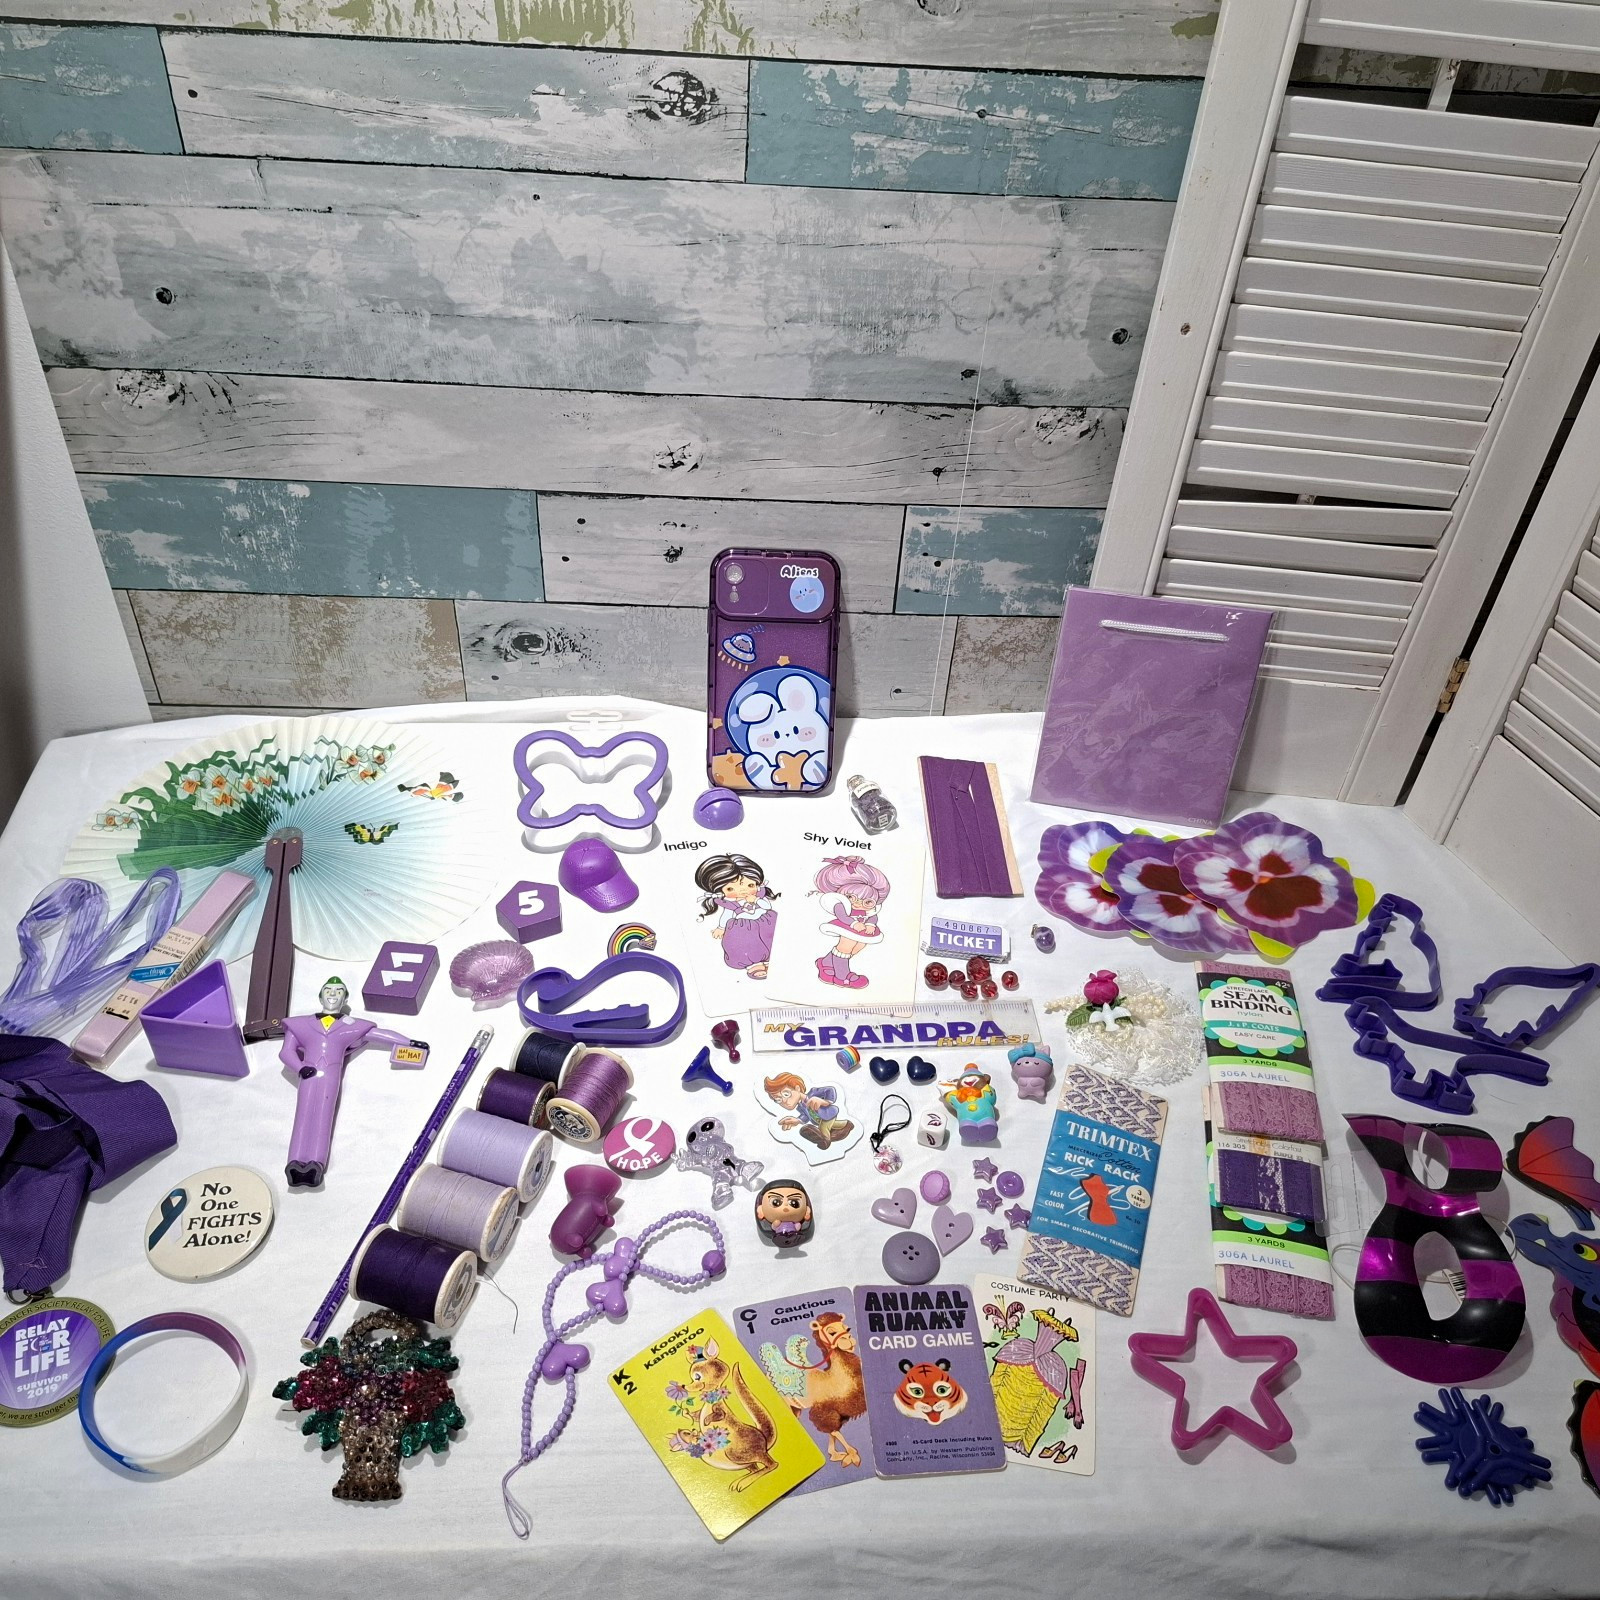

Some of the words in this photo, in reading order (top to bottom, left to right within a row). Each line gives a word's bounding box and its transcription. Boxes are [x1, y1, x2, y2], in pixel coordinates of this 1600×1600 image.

[781, 565, 818, 578] Aliens
[1187, 817, 1213, 825] CHINA
[664, 839, 708, 852] Indigo
[803, 832, 829, 845] Shy
[834, 836, 872, 851] Violet
[518, 889, 544, 915] 5
[944, 921, 990, 934] 490867
[936, 932, 996, 950] TICKET
[1223, 990, 1277, 1004] SEAM
[1211, 1000, 1292, 1016] BINDING
[764, 1023, 805, 1033] MY
[784, 1021, 1008, 1047] GRANDPA
[1251, 1024, 1280, 1032] COATS
[936, 1034, 1029, 1047] RULES!
[407, 1052, 421, 1060] HA!
[1249, 1059, 1278, 1067] YARDS
[1250, 1072, 1290, 1082] LAUREL
[1067, 1121, 1153, 1162] TRIMTEX
[1272, 1142, 1302, 1152] Colorfast
[1068, 1144, 1103, 1159] MERCERIZED
[616, 1152, 663, 1171] HOPE
[1064, 1152, 1095, 1168] RICK
[1104, 1163, 1141, 1183] RACK
[200, 1183, 232, 1197] No
[1050, 1190, 1064, 1199] FAST
[201, 1199, 239, 1212] One
[1044, 1199, 1065, 1210] COLOR
[187, 1212, 262, 1230] FIGHTS
[182, 1230, 251, 1248] Alone!
[1050, 1219, 1070, 1229] SMART
[1072, 1226, 1107, 1242] DECORATIVE
[1109, 1238, 1139, 1254] TRIMMING
[1256, 1238, 1286, 1248] YARDS
[1218, 1250, 1248, 1261] 306A
[1252, 1254, 1295, 1269] LAUREL
[990, 1281, 1036, 1296] COSTUME
[1039, 1291, 1071, 1303] PARTY
[774, 1298, 836, 1316] Cautious
[864, 1290, 969, 1312] ANIMAL
[0, 1308, 33, 1330] CANCER
[36, 1300, 69, 1311] SOCIETY
[70, 1301, 94, 1313] RELAY
[93, 1311, 105, 1322] FOR
[100, 1321, 110, 1339] LIFE
[740, 1309, 758, 1322] C
[770, 1311, 815, 1326] Camel
[868, 1310, 966, 1333] RUMMY
[16, 1317, 70, 1341] RELAY
[746, 1321, 755, 1335] 1
[643, 1327, 705, 1370] Kangaroo
[650, 1326, 690, 1355] Kooky
[868, 1334, 917, 1350] CARD
[922, 1332, 975, 1348] GAME
[15, 1347, 70, 1378] LIFE
[17, 1373, 69, 1393] SURVIVOR
[612, 1368, 632, 1386] K
[27, 1384, 58, 1399] 2019
[623, 1381, 638, 1395] 2
[34, 1402, 66, 1418] stronger
